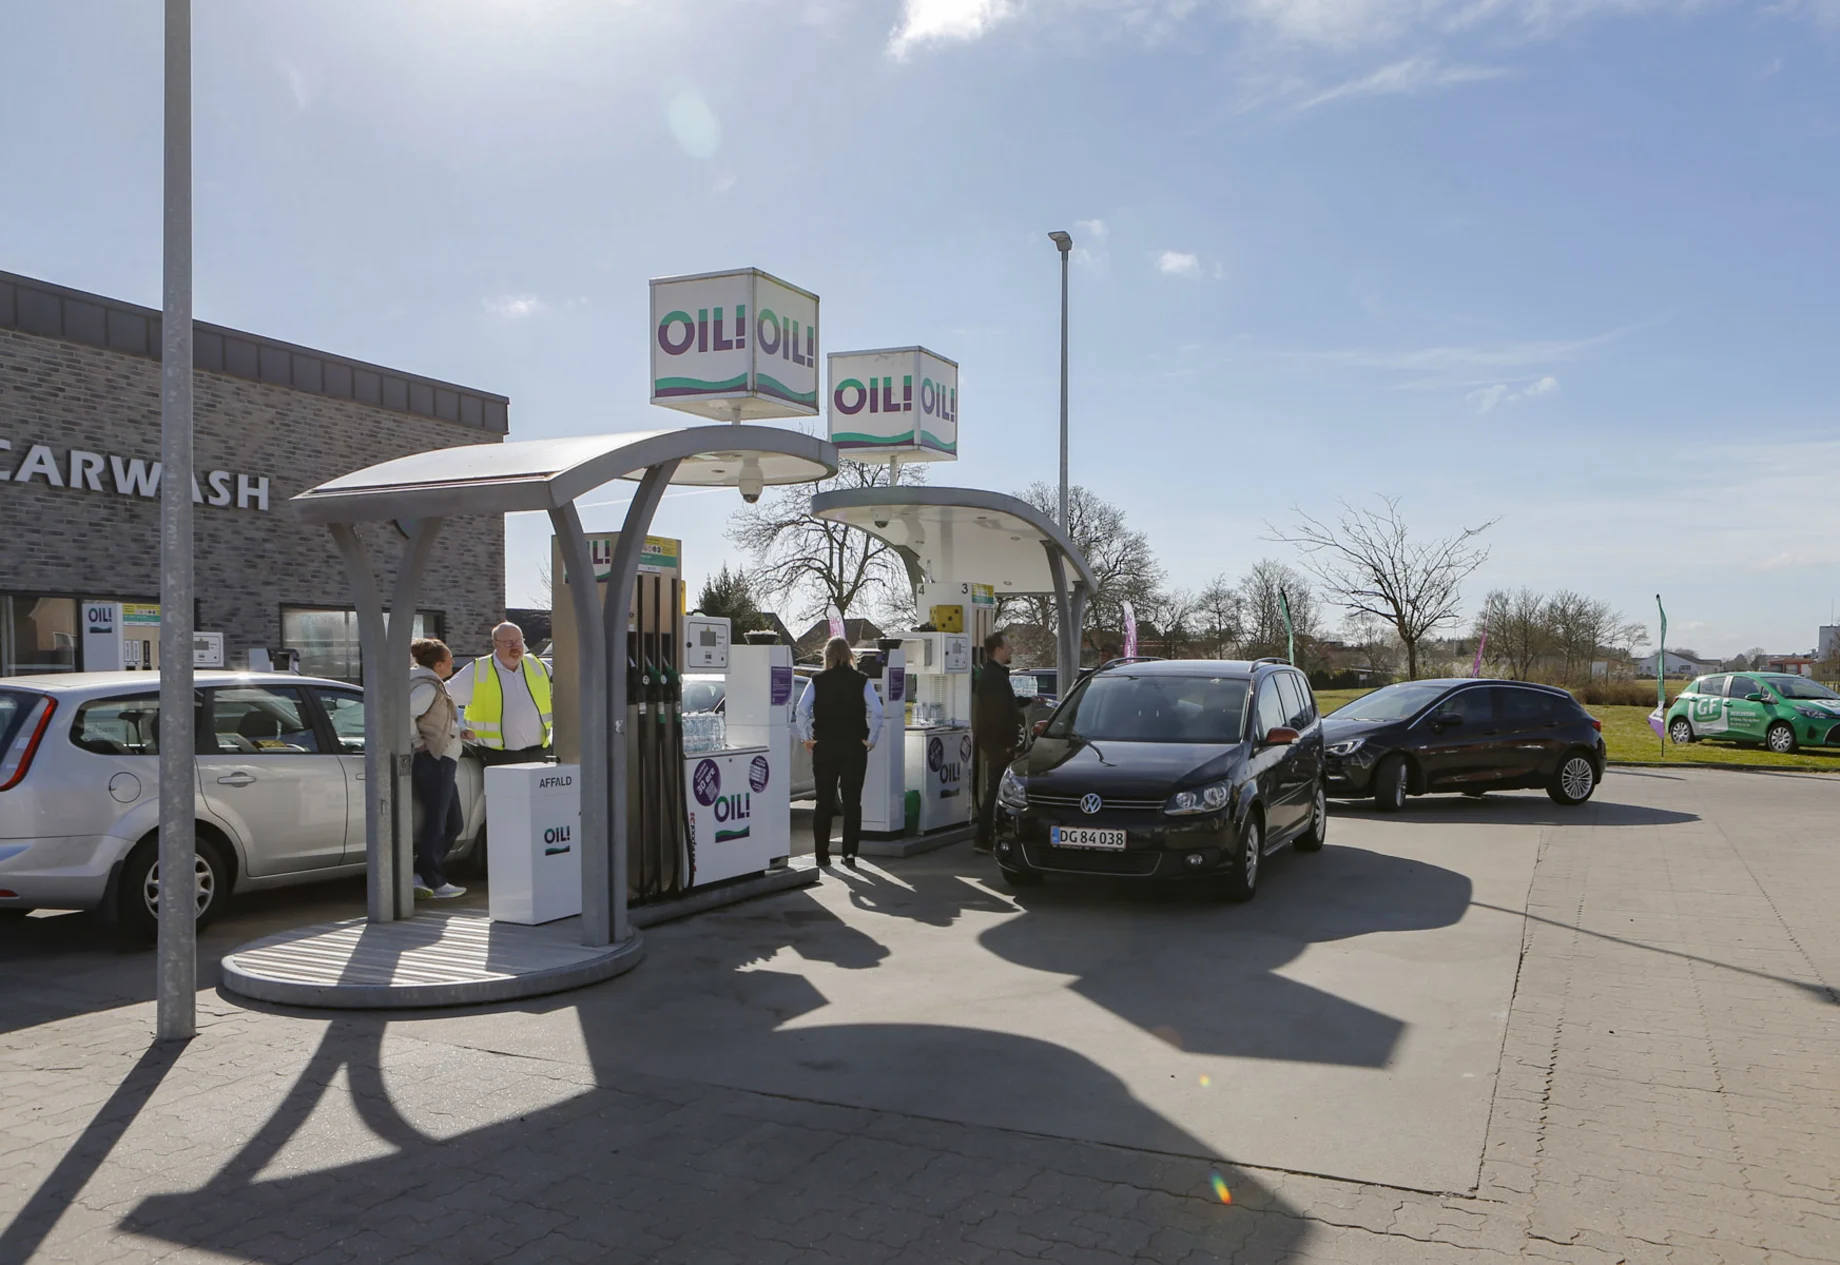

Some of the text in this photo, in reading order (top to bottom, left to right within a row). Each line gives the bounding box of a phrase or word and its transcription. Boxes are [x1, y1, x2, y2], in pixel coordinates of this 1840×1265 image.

[657, 304, 746, 356] OIL!
[757, 308, 814, 368] OIL!
[833, 375, 913, 415] OIL!
[921, 377, 955, 423] OIL!
[918, 584, 925, 595] 4
[961, 583, 969, 595] 3
[88, 607, 113, 623] OIL!
[1697, 697, 1719, 716] GF
[539, 776, 573, 789] AFFALD
[940, 762, 960, 784] OIL!
[714, 792, 750, 823] OIL!
[544, 825, 570, 844] OIL!
[1060, 830, 1077, 843] DG
[1080, 831, 1096, 844] 84
[1100, 832, 1124, 846] 038
